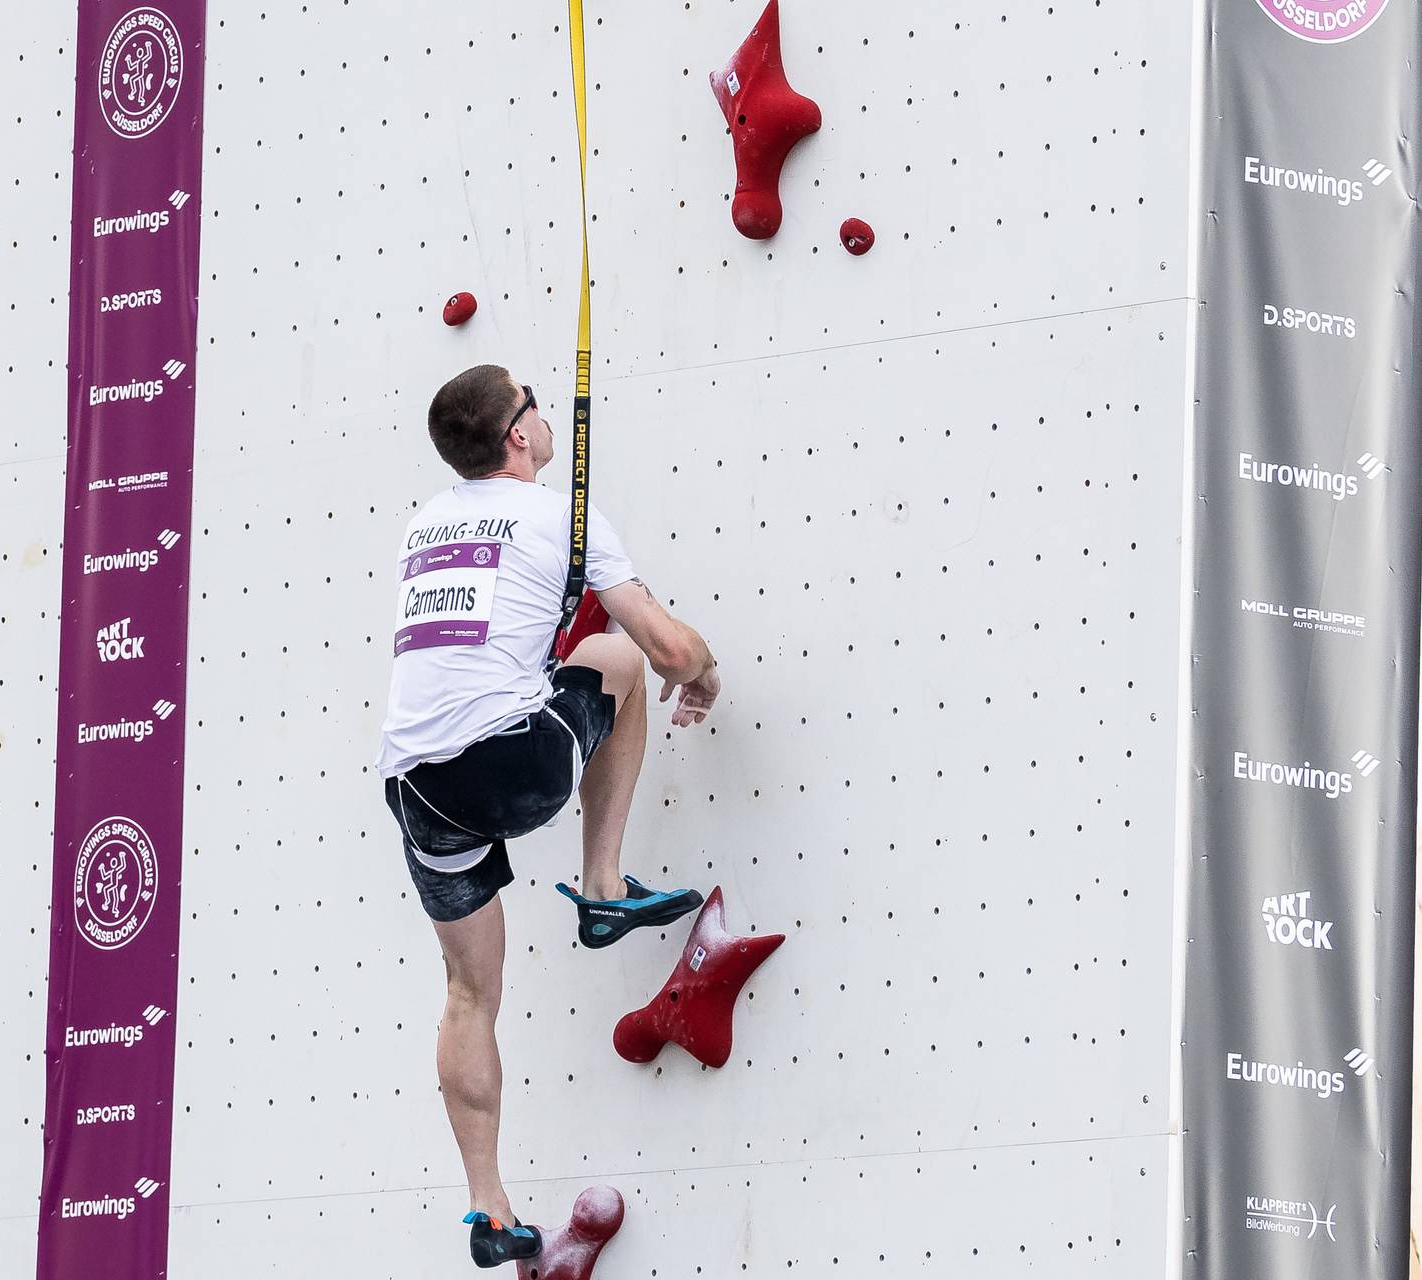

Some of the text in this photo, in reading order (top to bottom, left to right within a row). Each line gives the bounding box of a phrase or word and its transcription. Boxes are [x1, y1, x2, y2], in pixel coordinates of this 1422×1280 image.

[102, 13, 179, 85] EUROWINGS SPEED CIRCUS
[112, 102, 163, 132] DÜSSELDORF
[1244, 156, 1364, 206] Eurowings
[93, 209, 169, 237] Eurowings
[100, 288, 162, 312] D.SPORTS
[1263, 304, 1356, 338] D.SPORTS
[89, 378, 163, 406] Eurowings
[88, 471, 168, 492] MOLL GRUPPE
[573, 423, 586, 550] PERFECT DESCENT
[1239, 452, 1358, 501] Eurowings
[407, 518, 519, 550] CHUNG-BUK
[83, 547, 159, 575] Eurowings
[404, 586, 476, 619] Carmanns
[1241, 599, 1366, 628] MOLL GRUPPE
[96, 617, 131, 641] ART
[1292, 621, 1365, 637] AUTO PERFORMANCE
[96, 636, 145, 662] ROCK
[78, 717, 154, 744] Eurowings
[1233, 751, 1353, 799] Eurowings
[76, 823, 153, 893] EUROWINGS SPEED CIRCUS
[1261, 890, 1311, 917] ART
[84, 915, 138, 943] DÜSSELDORF
[1261, 912, 1333, 950] ROCK
[65, 1022, 143, 1047] Eurowings
[1227, 1052, 1345, 1099] Eurowings
[77, 1104, 135, 1125] D.SPORTS
[61, 1194, 135, 1219] Eurowings
[1246, 1217, 1300, 1236] BildWerbung
